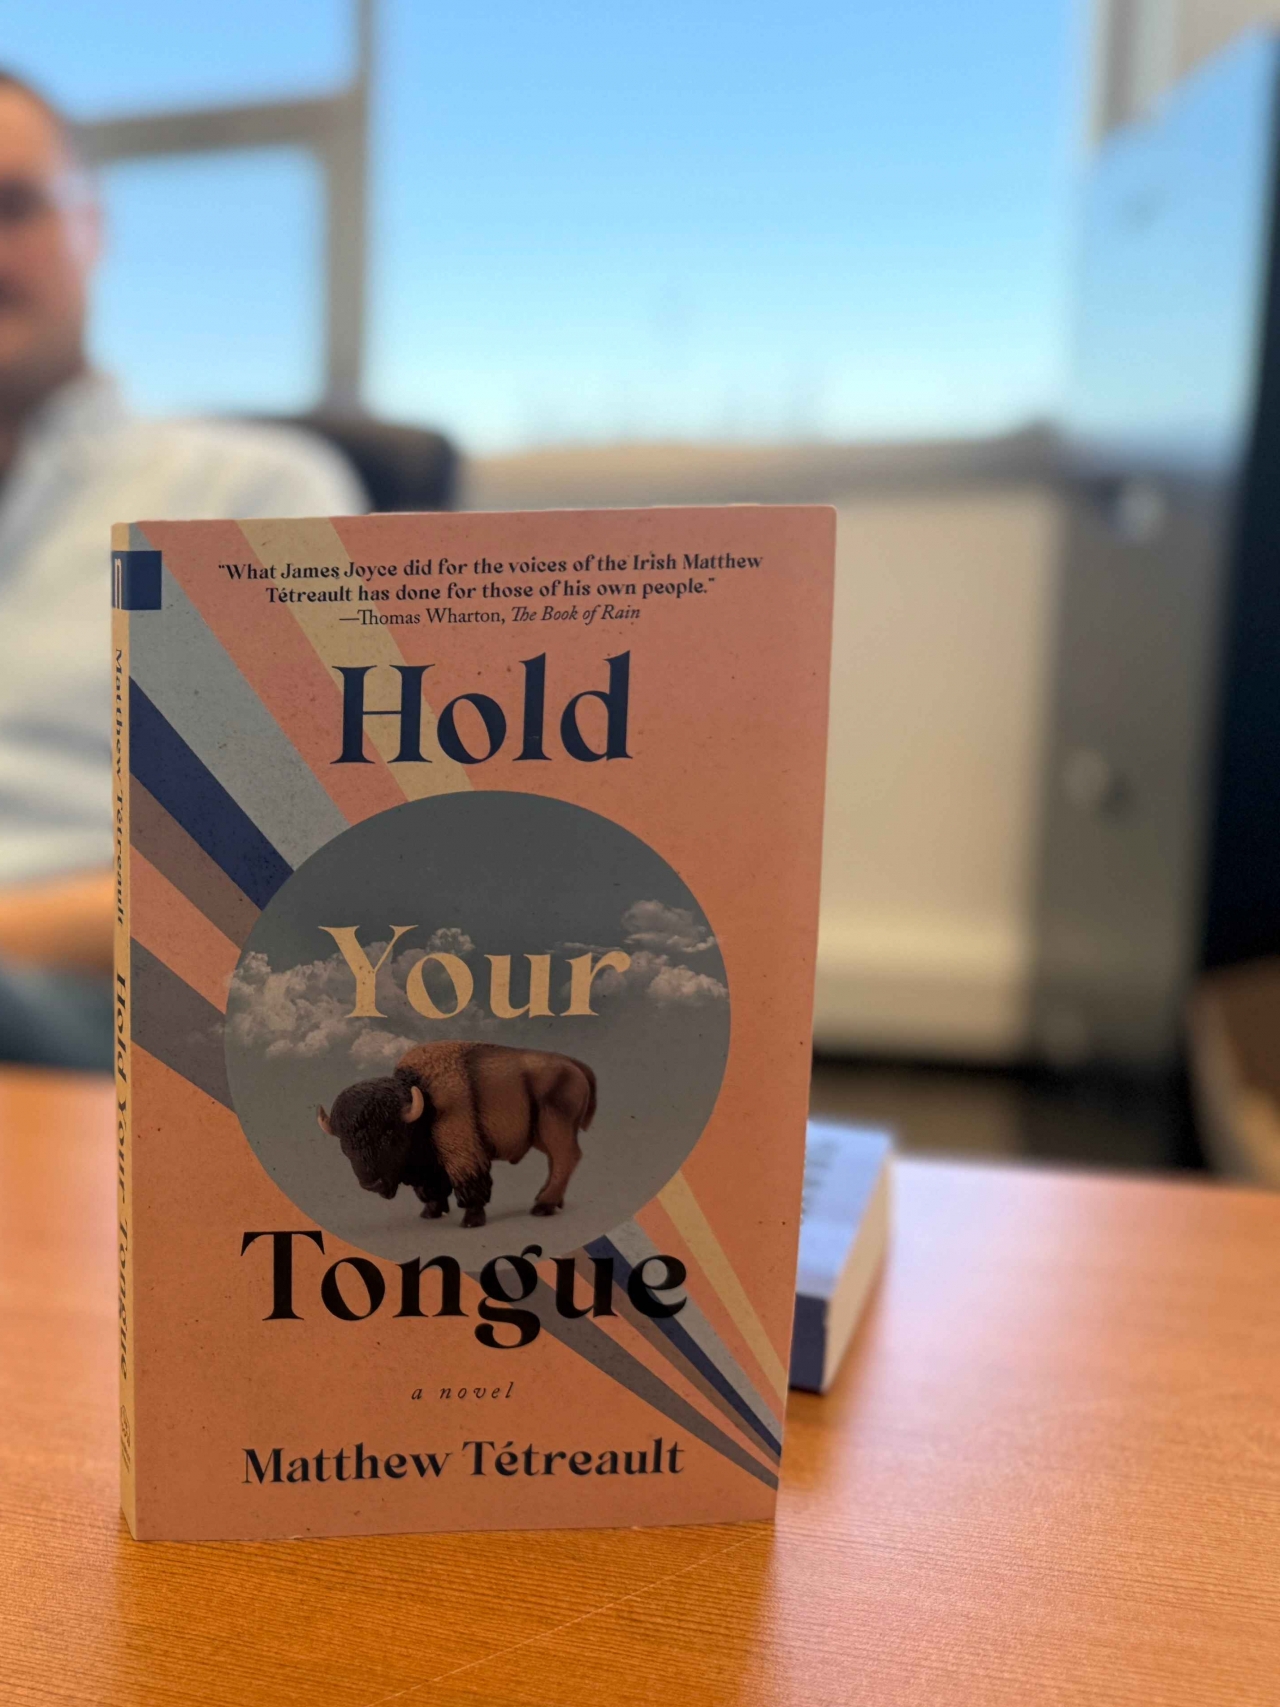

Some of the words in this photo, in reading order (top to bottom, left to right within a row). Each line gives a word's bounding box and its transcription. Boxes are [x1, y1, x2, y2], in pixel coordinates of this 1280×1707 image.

[265, 585, 353, 603] Tétreault
[358, 585, 390, 602] has
[395, 584, 441, 601] done
[446, 582, 477, 600] for
[482, 581, 534, 599] those
[539, 579, 561, 597] of
[563, 579, 591, 596] his
[596, 582, 636, 596] own
[281, 563, 340, 580] James
[343, 561, 398, 582] Joyce
[403, 559, 432, 577] did
[438, 558, 468, 576] for
[474, 557, 503, 574] the
[509, 556, 567, 573] voices
[572, 554, 595, 572] of
[597, 554, 627, 571] the
[633, 552, 677, 570] Irish
[683, 552, 763, 570] Matthew
[425, 607, 506, 624] Wharton,
[511, 606, 537, 622] The
[540, 605, 579, 621] Book
[582, 605, 601, 626] of
[601, 604, 641, 620] Rain
[115, 648, 123, 780] Matthew
[330, 649, 633, 766] Hold
[318, 924, 632, 1020] Your
[116, 971, 127, 1084] Hold
[118, 1098, 127, 1205] Your
[118, 1218, 128, 1380] Tongue
[240, 1230, 689, 1349] Tongue
[411, 1387, 423, 1400] a
[439, 1381, 515, 1400] novel
[241, 1442, 453, 1485] Matthew
[461, 1437, 685, 1477] Tétreault
